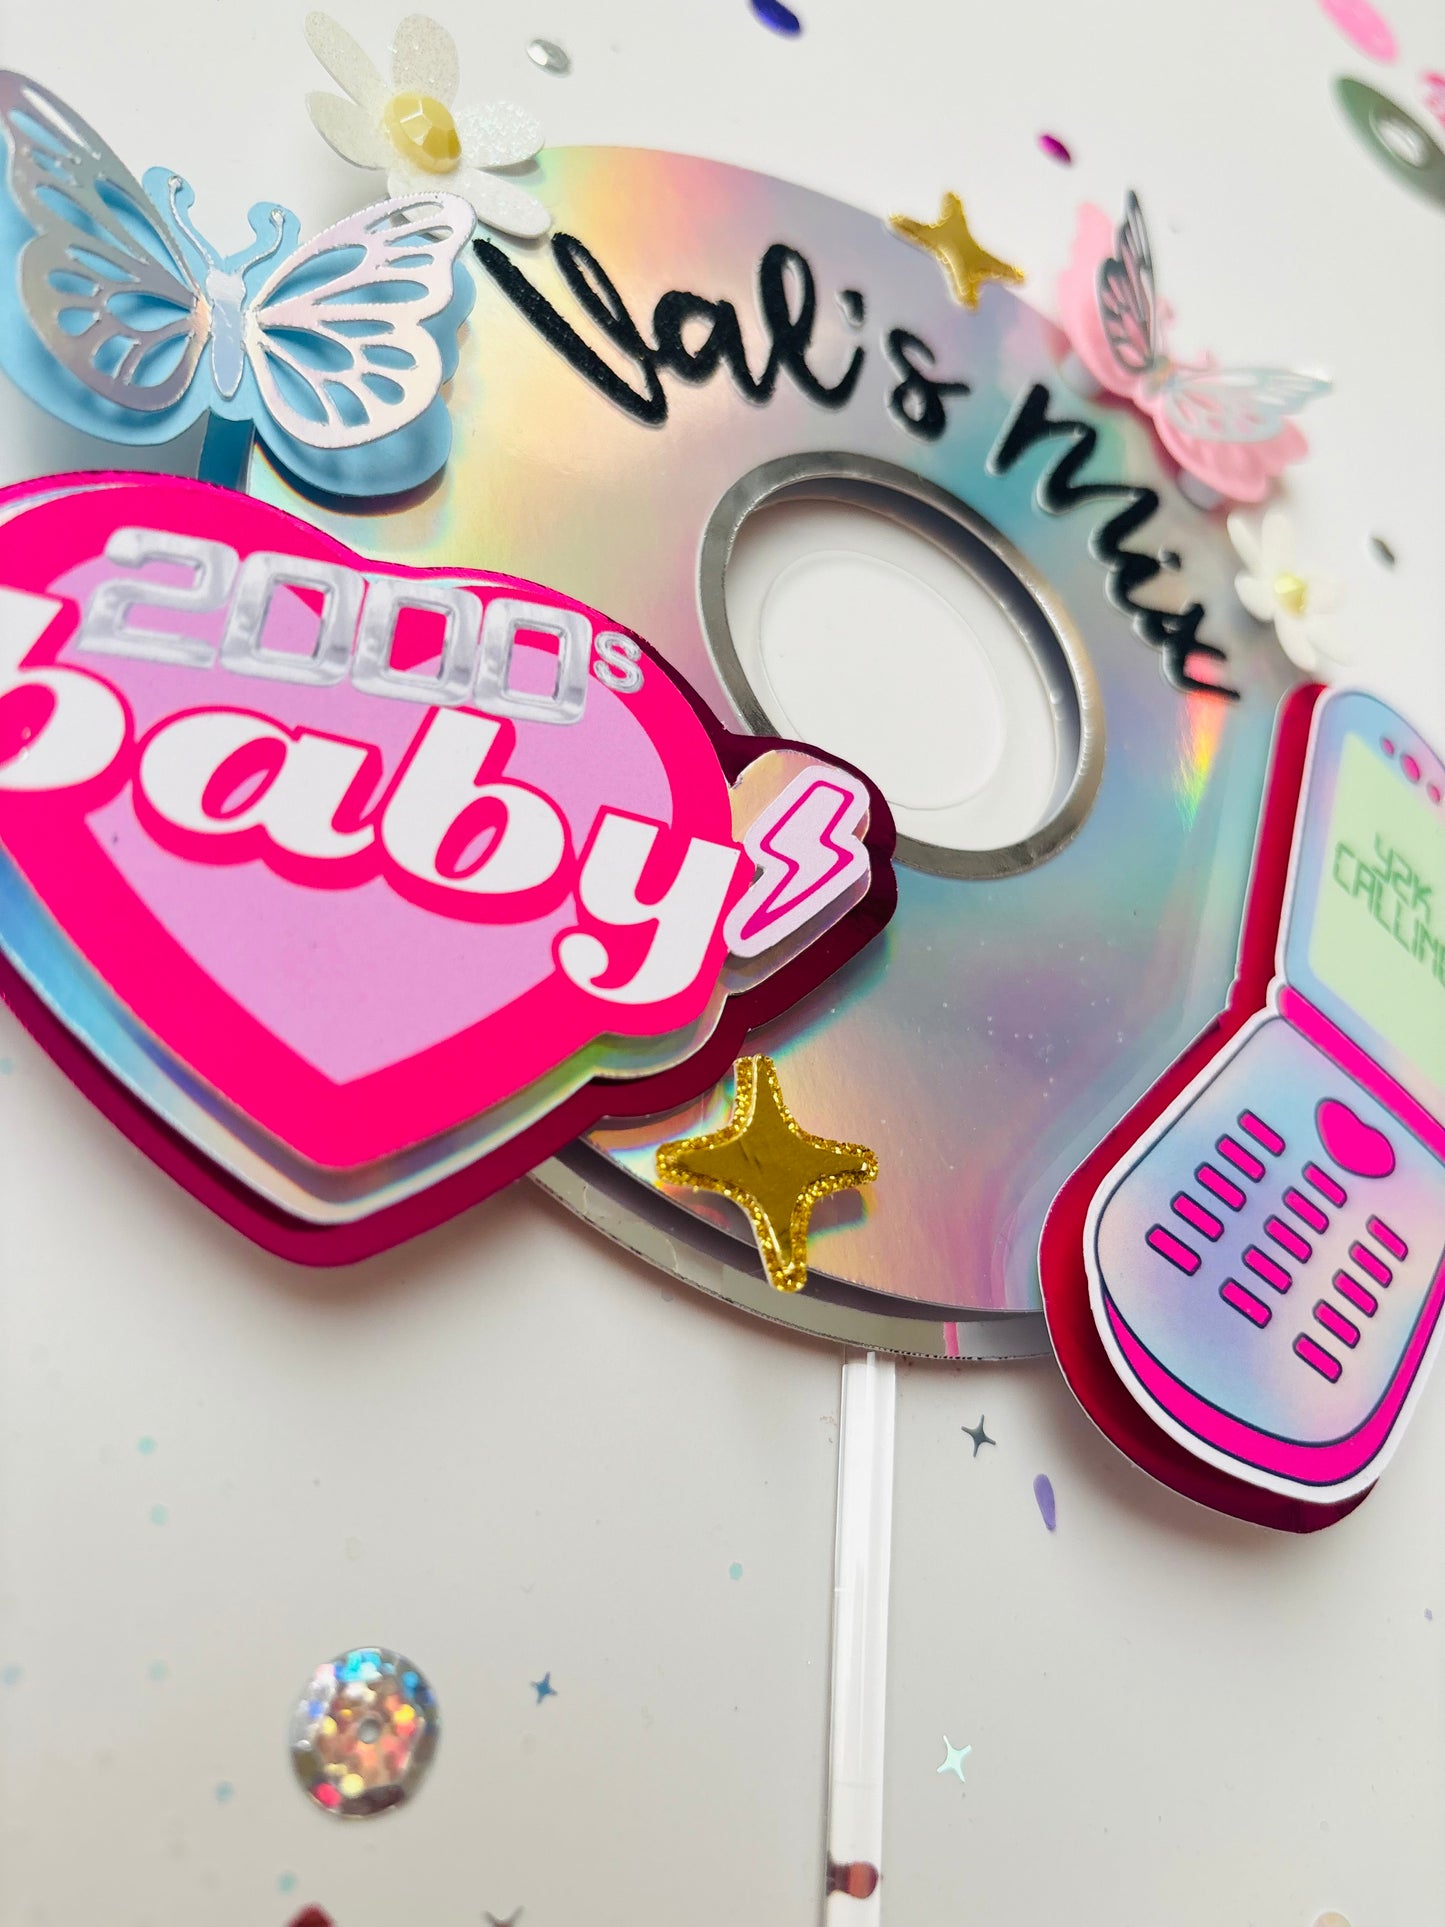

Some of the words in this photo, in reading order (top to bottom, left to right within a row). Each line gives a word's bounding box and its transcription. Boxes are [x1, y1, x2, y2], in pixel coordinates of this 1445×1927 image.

[473, 231, 970, 440] Val's
[987, 383, 1242, 702] mix
[76, 526, 645, 725] 2000s
[0, 586, 741, 1005] baby
[1371, 831, 1434, 927] Y2K
